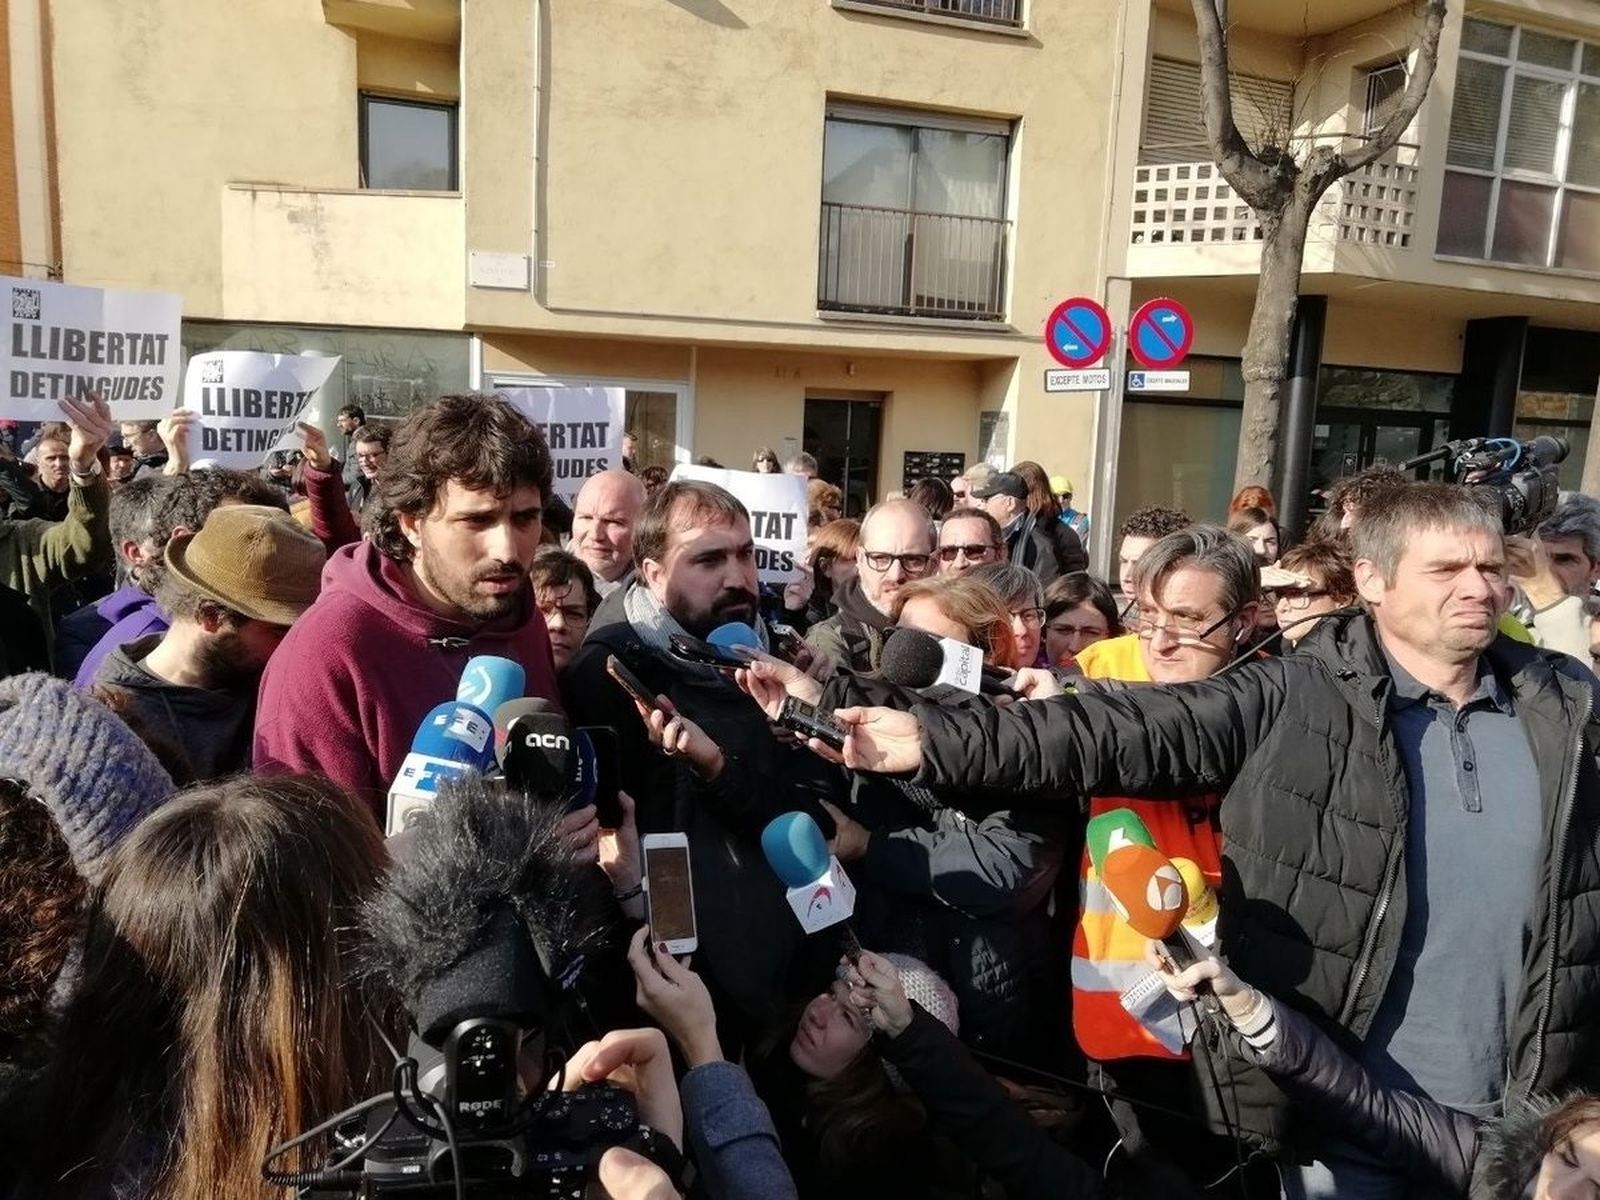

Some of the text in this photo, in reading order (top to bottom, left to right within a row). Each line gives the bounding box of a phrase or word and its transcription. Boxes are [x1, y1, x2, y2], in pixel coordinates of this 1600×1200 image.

[12, 323, 168, 365] LLIBERTAT
[10, 370, 164, 402] DETINGUDES
[525, 733, 570, 751] acn
